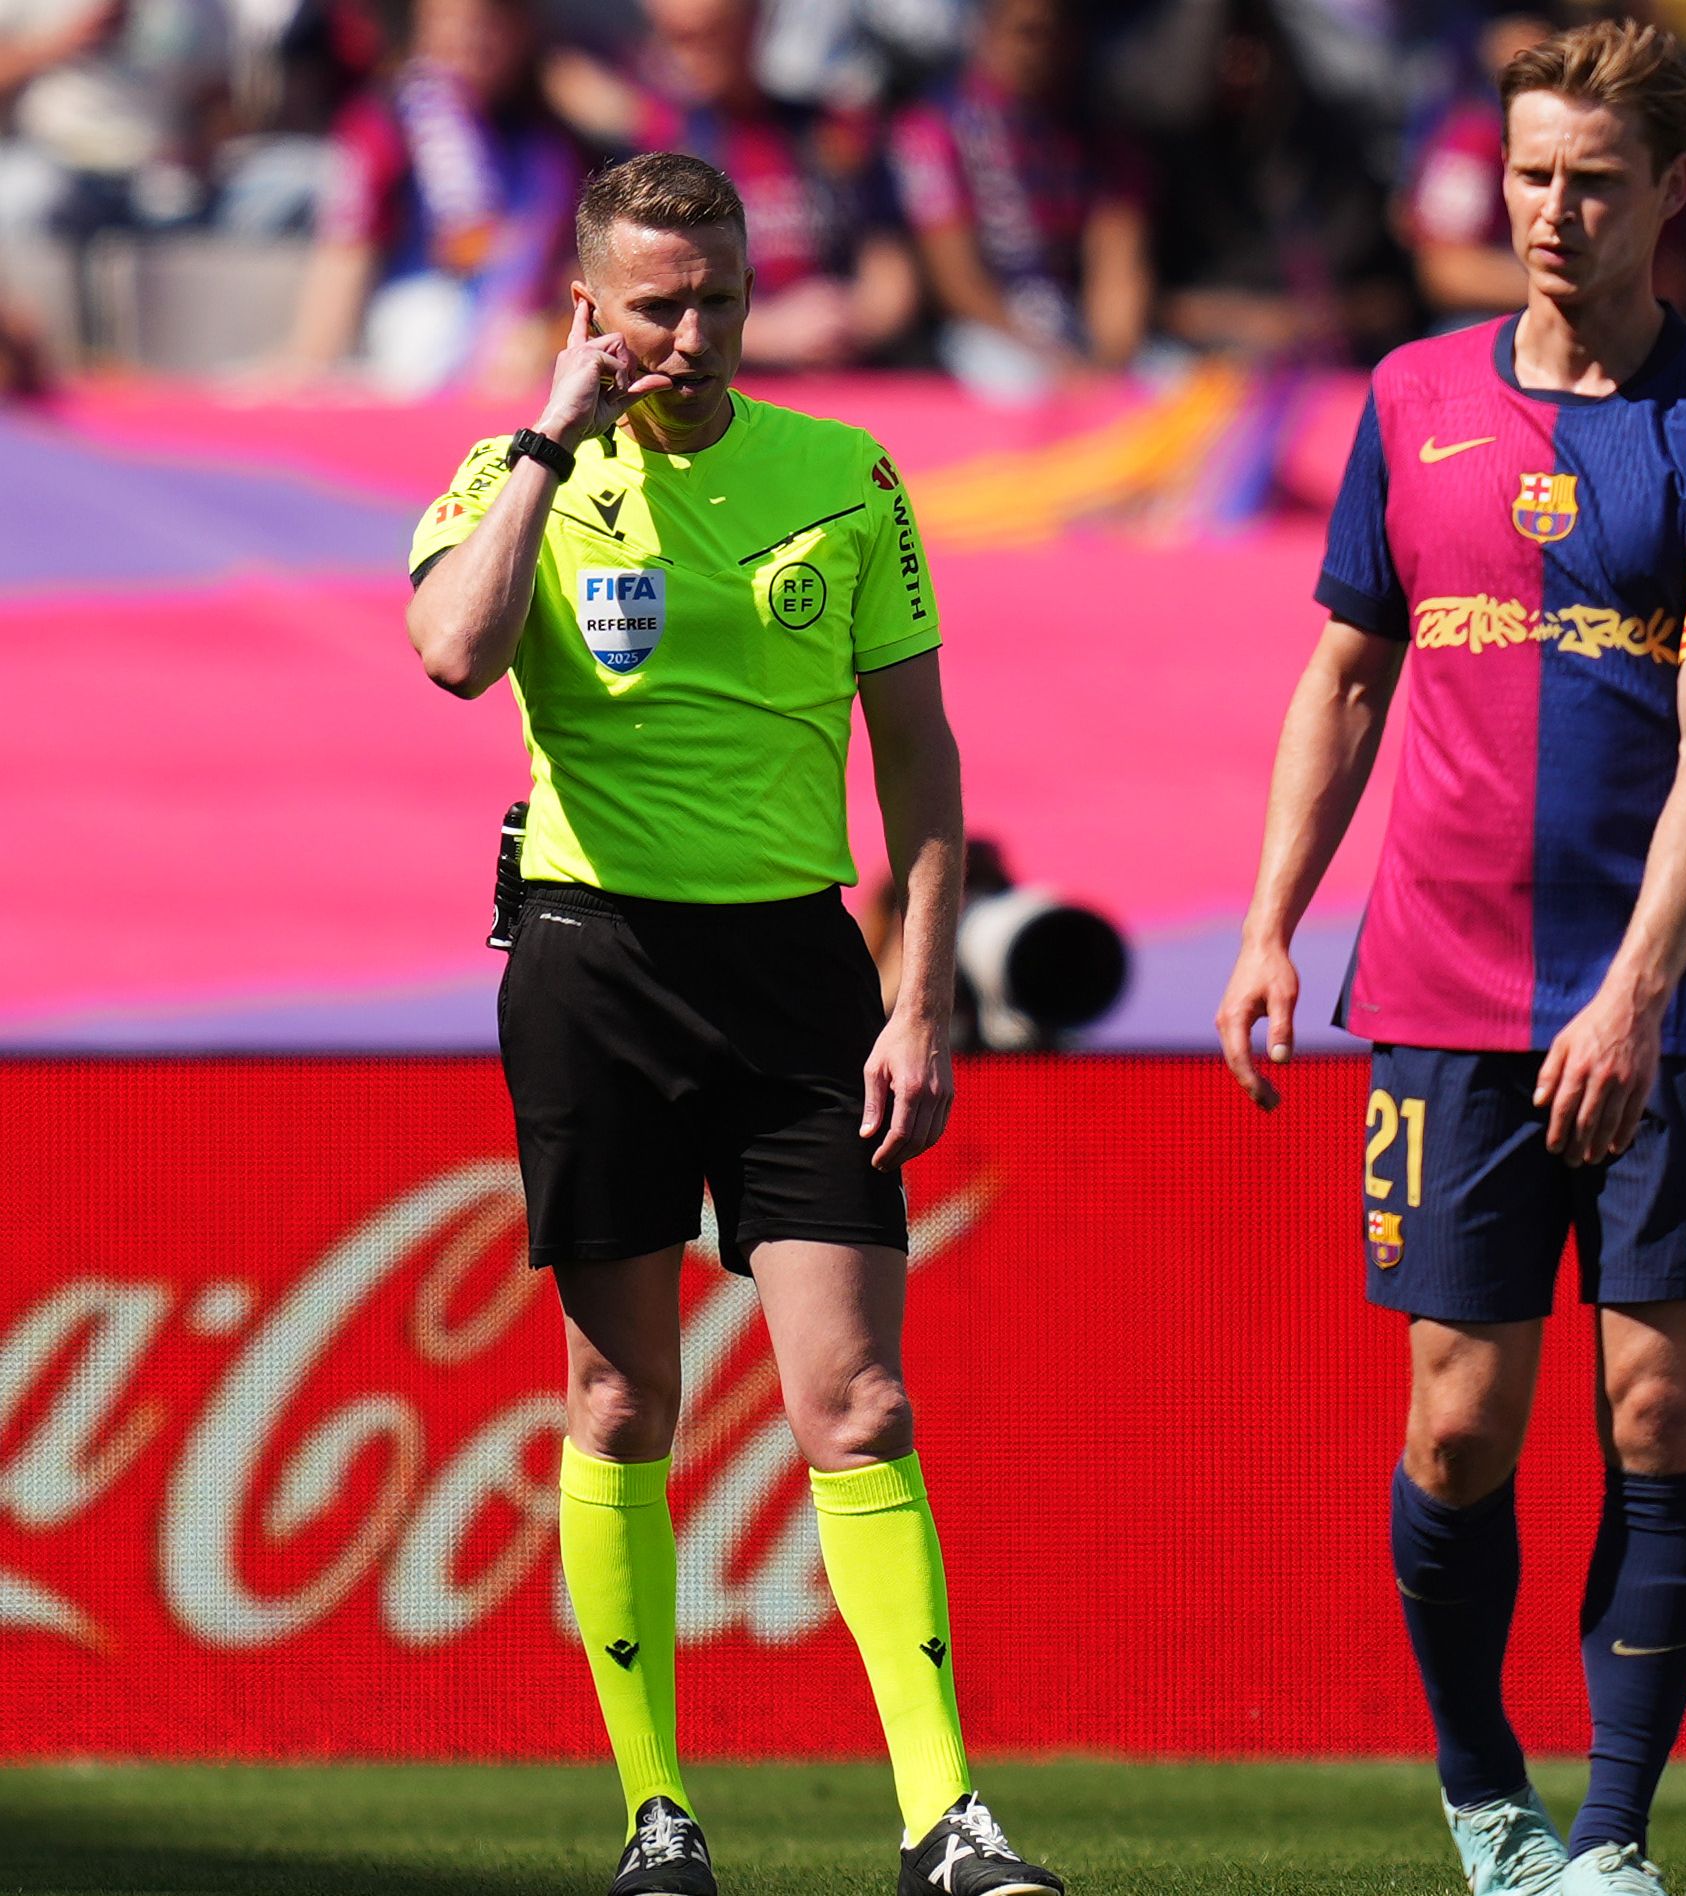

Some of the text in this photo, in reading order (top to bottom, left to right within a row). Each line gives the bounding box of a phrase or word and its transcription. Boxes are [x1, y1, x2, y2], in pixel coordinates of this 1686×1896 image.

[893, 494, 928, 621] WÜRTH
[586, 576, 657, 601] FIFA
[586, 617, 657, 632] REFEREE
[606, 652, 640, 665] 2025
[1365, 1087, 1426, 1208] 21
